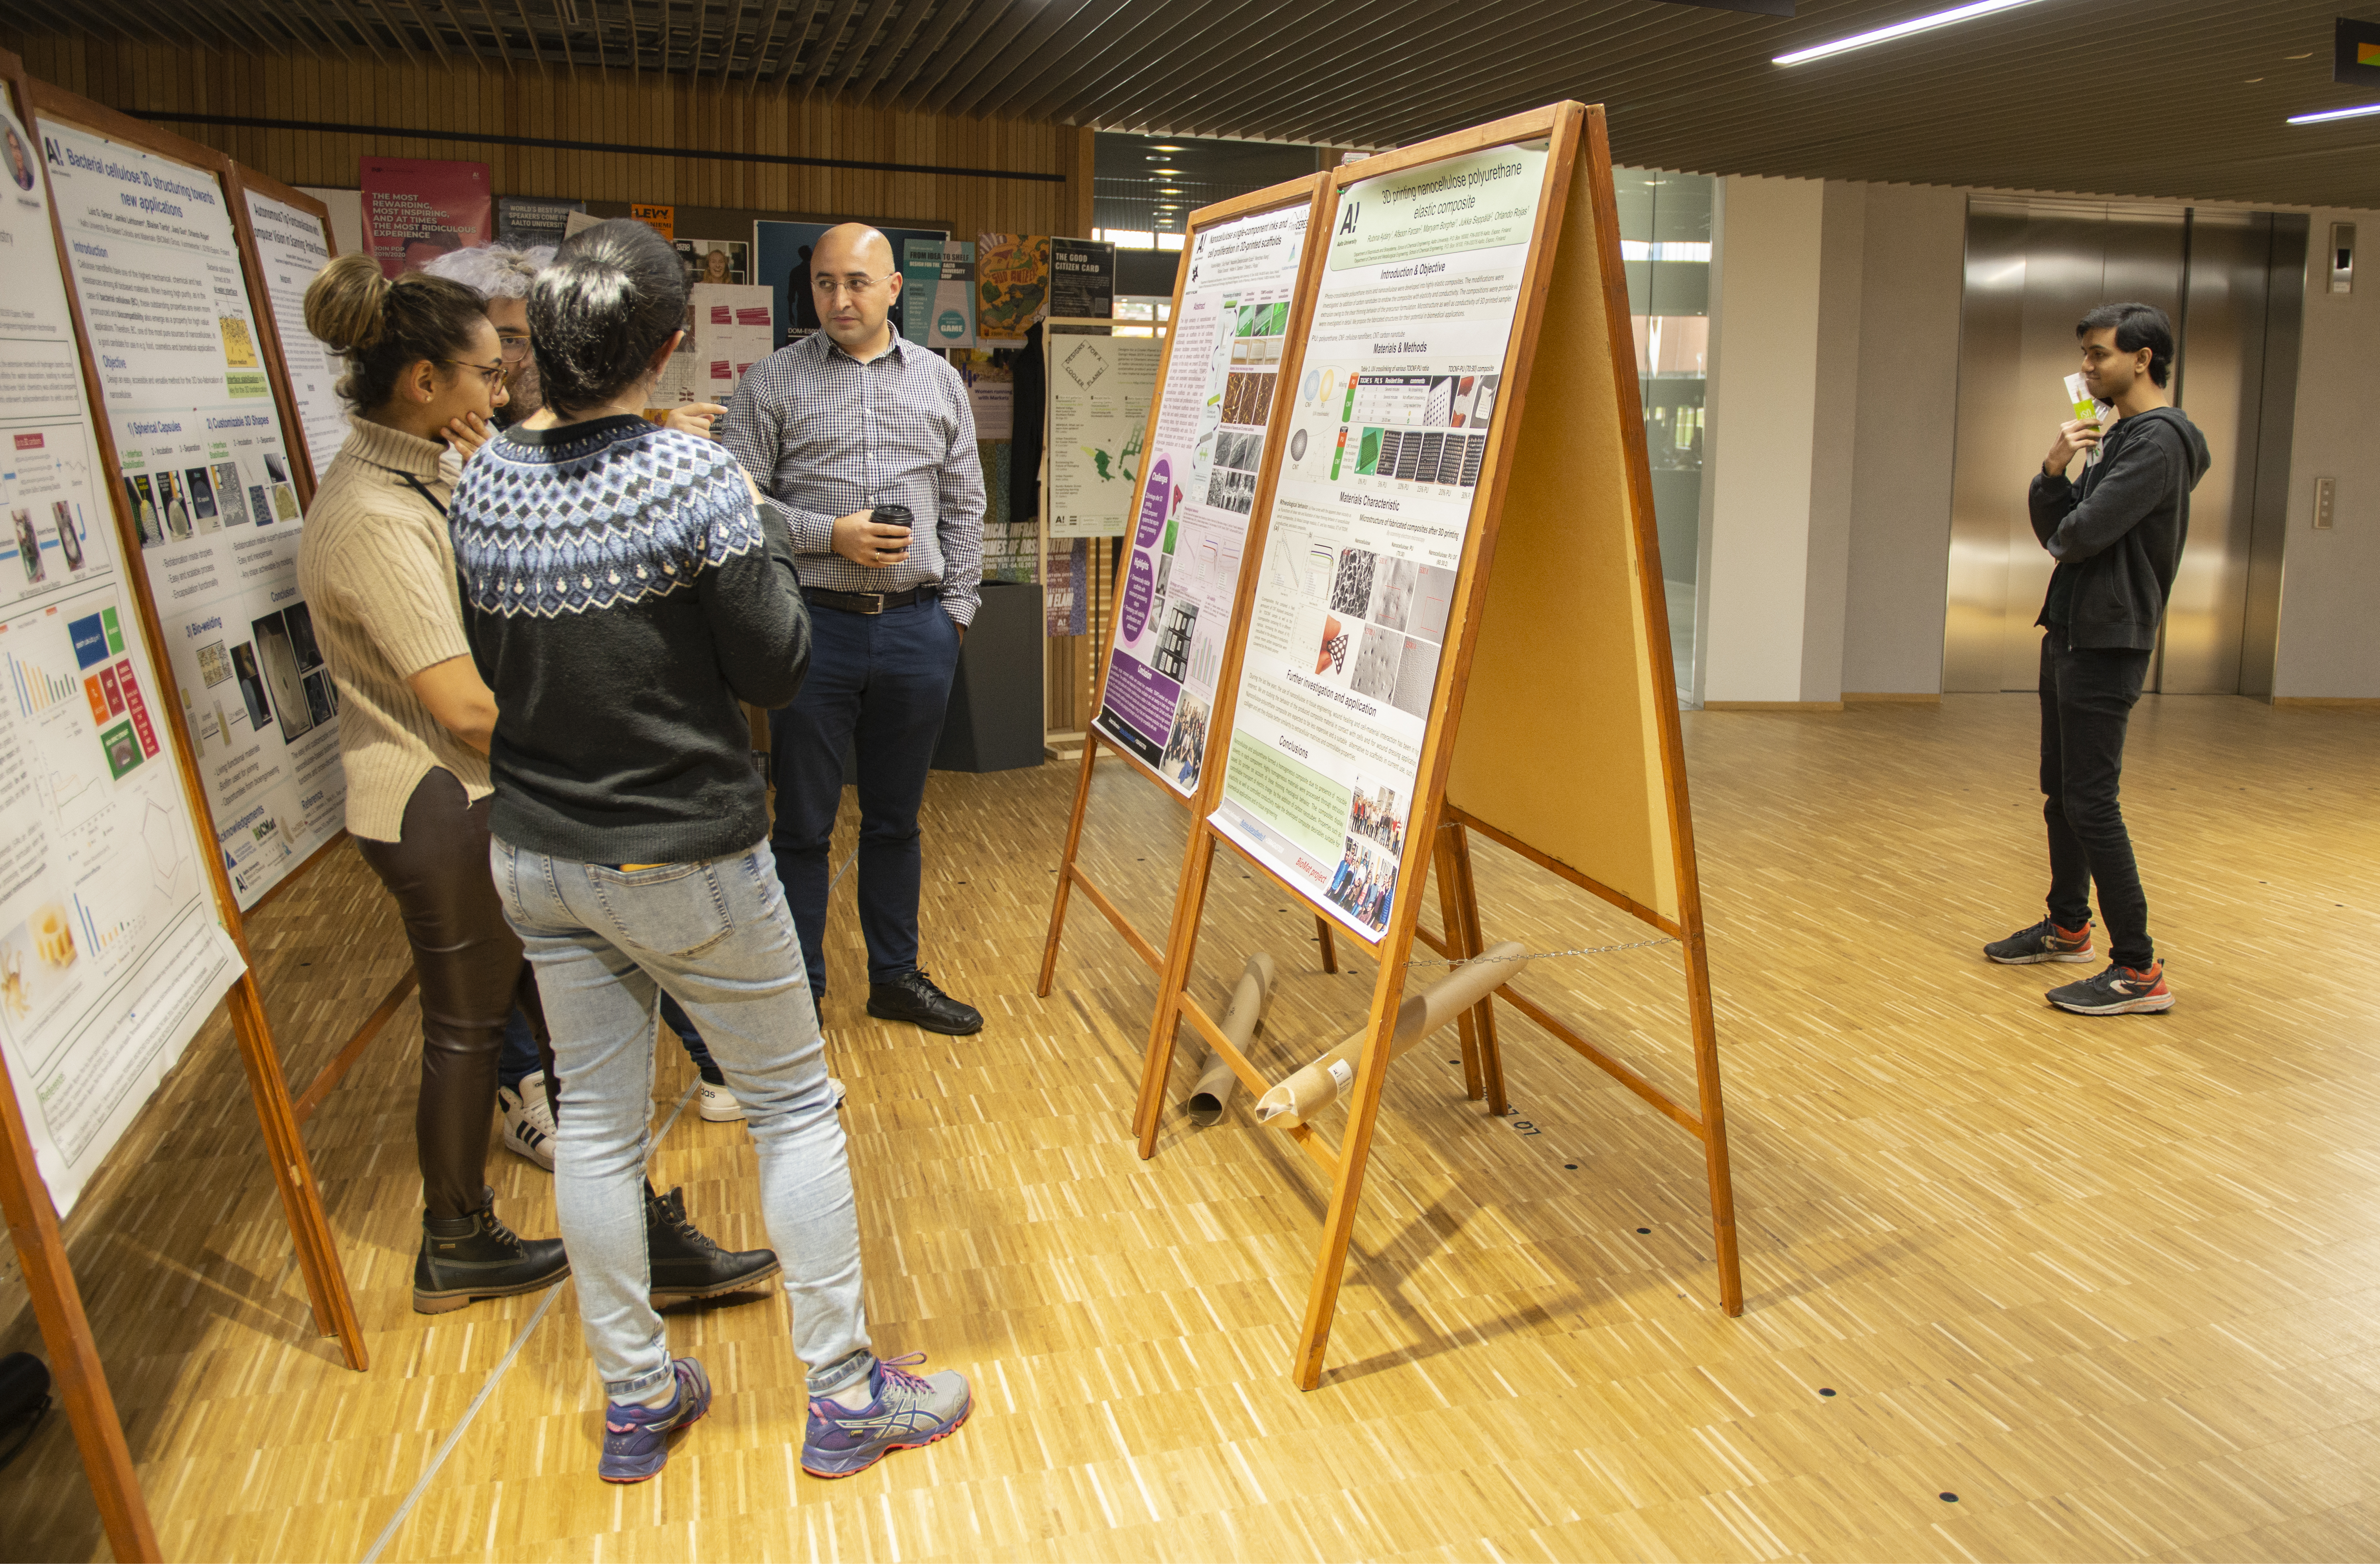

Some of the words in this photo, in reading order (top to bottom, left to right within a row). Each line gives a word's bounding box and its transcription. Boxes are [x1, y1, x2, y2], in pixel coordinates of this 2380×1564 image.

[45, 137, 64, 166] A!
[66, 148, 104, 174] Bacterial
[105, 163, 140, 185] cellulose
[140, 171, 152, 187] 3D
[153, 176, 192, 202] structuring
[192, 189, 215, 205] towards
[1382, 190, 1391, 204] 3D
[1393, 186, 1416, 205] printing
[1418, 174, 1466, 196] nanocellulose
[1468, 163, 1521, 189] polyurethane
[121, 191, 137, 208] new
[140, 196, 183, 218] applications
[373, 200, 432, 211] REWARDING,
[401, 209, 450, 218] INSPIRING,
[1414, 202, 1436, 218] elastic
[1438, 194, 1475, 215] composite
[1340, 202, 1359, 235] A!
[374, 230, 430, 238] EXPERIENCE
[422, 224, 476, 233] RIDICULOUS
[1209, 231, 1233, 244] Nanocellulose
[1233, 224, 1268, 240] single-component
[1269, 220, 1278, 230] inks
[1278, 217, 1288, 229] and
[72, 239, 108, 259] Introduction
[1197, 234, 1207, 254] A!
[1213, 243, 1235, 260] proliferation
[1240, 239, 1261, 253] 3D-printed
[1261, 235, 1281, 248] scaffolds
[1056, 262, 1079, 271] CITIZEN
[1081, 264, 1099, 272] CARD
[1380, 267, 1413, 279] Introduction
[1414, 264, 1418, 275] &
[1420, 262, 1445, 276] Objective
[1065, 343, 1085, 364] DESIGNS
[1088, 345, 1098, 357] FOR
[1373, 343, 1396, 354] Materials
[1398, 342, 1401, 353] &
[1403, 341, 1427, 353] Methods
[102, 355, 127, 370] Objective
[1066, 367, 1084, 387] COOLER
[1087, 368, 1104, 387] PLANET
[133, 422, 158, 437] Spherical
[158, 421, 182, 435] Capsules
[213, 416, 244, 429] Customizable
[245, 416, 251, 426] 3D
[251, 414, 269, 427] Shapes
[1152, 472, 1168, 485] Challenges
[1280, 499, 1297, 508] Rheological
[1340, 492, 1362, 505] Materials
[1363, 495, 1400, 511] Characteristic
[1359, 514, 1384, 525] Microstructure
[1388, 519, 1407, 530] fabricated
[1407, 524, 1428, 534] composites
[1428, 527, 1438, 535] after
[1438, 528, 1444, 536] 3D
[1444, 530, 1459, 541] printing
[1134, 558, 1149, 571] Highlights
[1286, 669, 1303, 687] Further
[1303, 677, 1334, 699] investigation
[1334, 692, 1345, 704] and
[1345, 698, 1376, 717] application
[1279, 735, 1308, 759] Conclusions
[1296, 857, 1312, 874] BioMat
[1309, 869, 1327, 884] project
